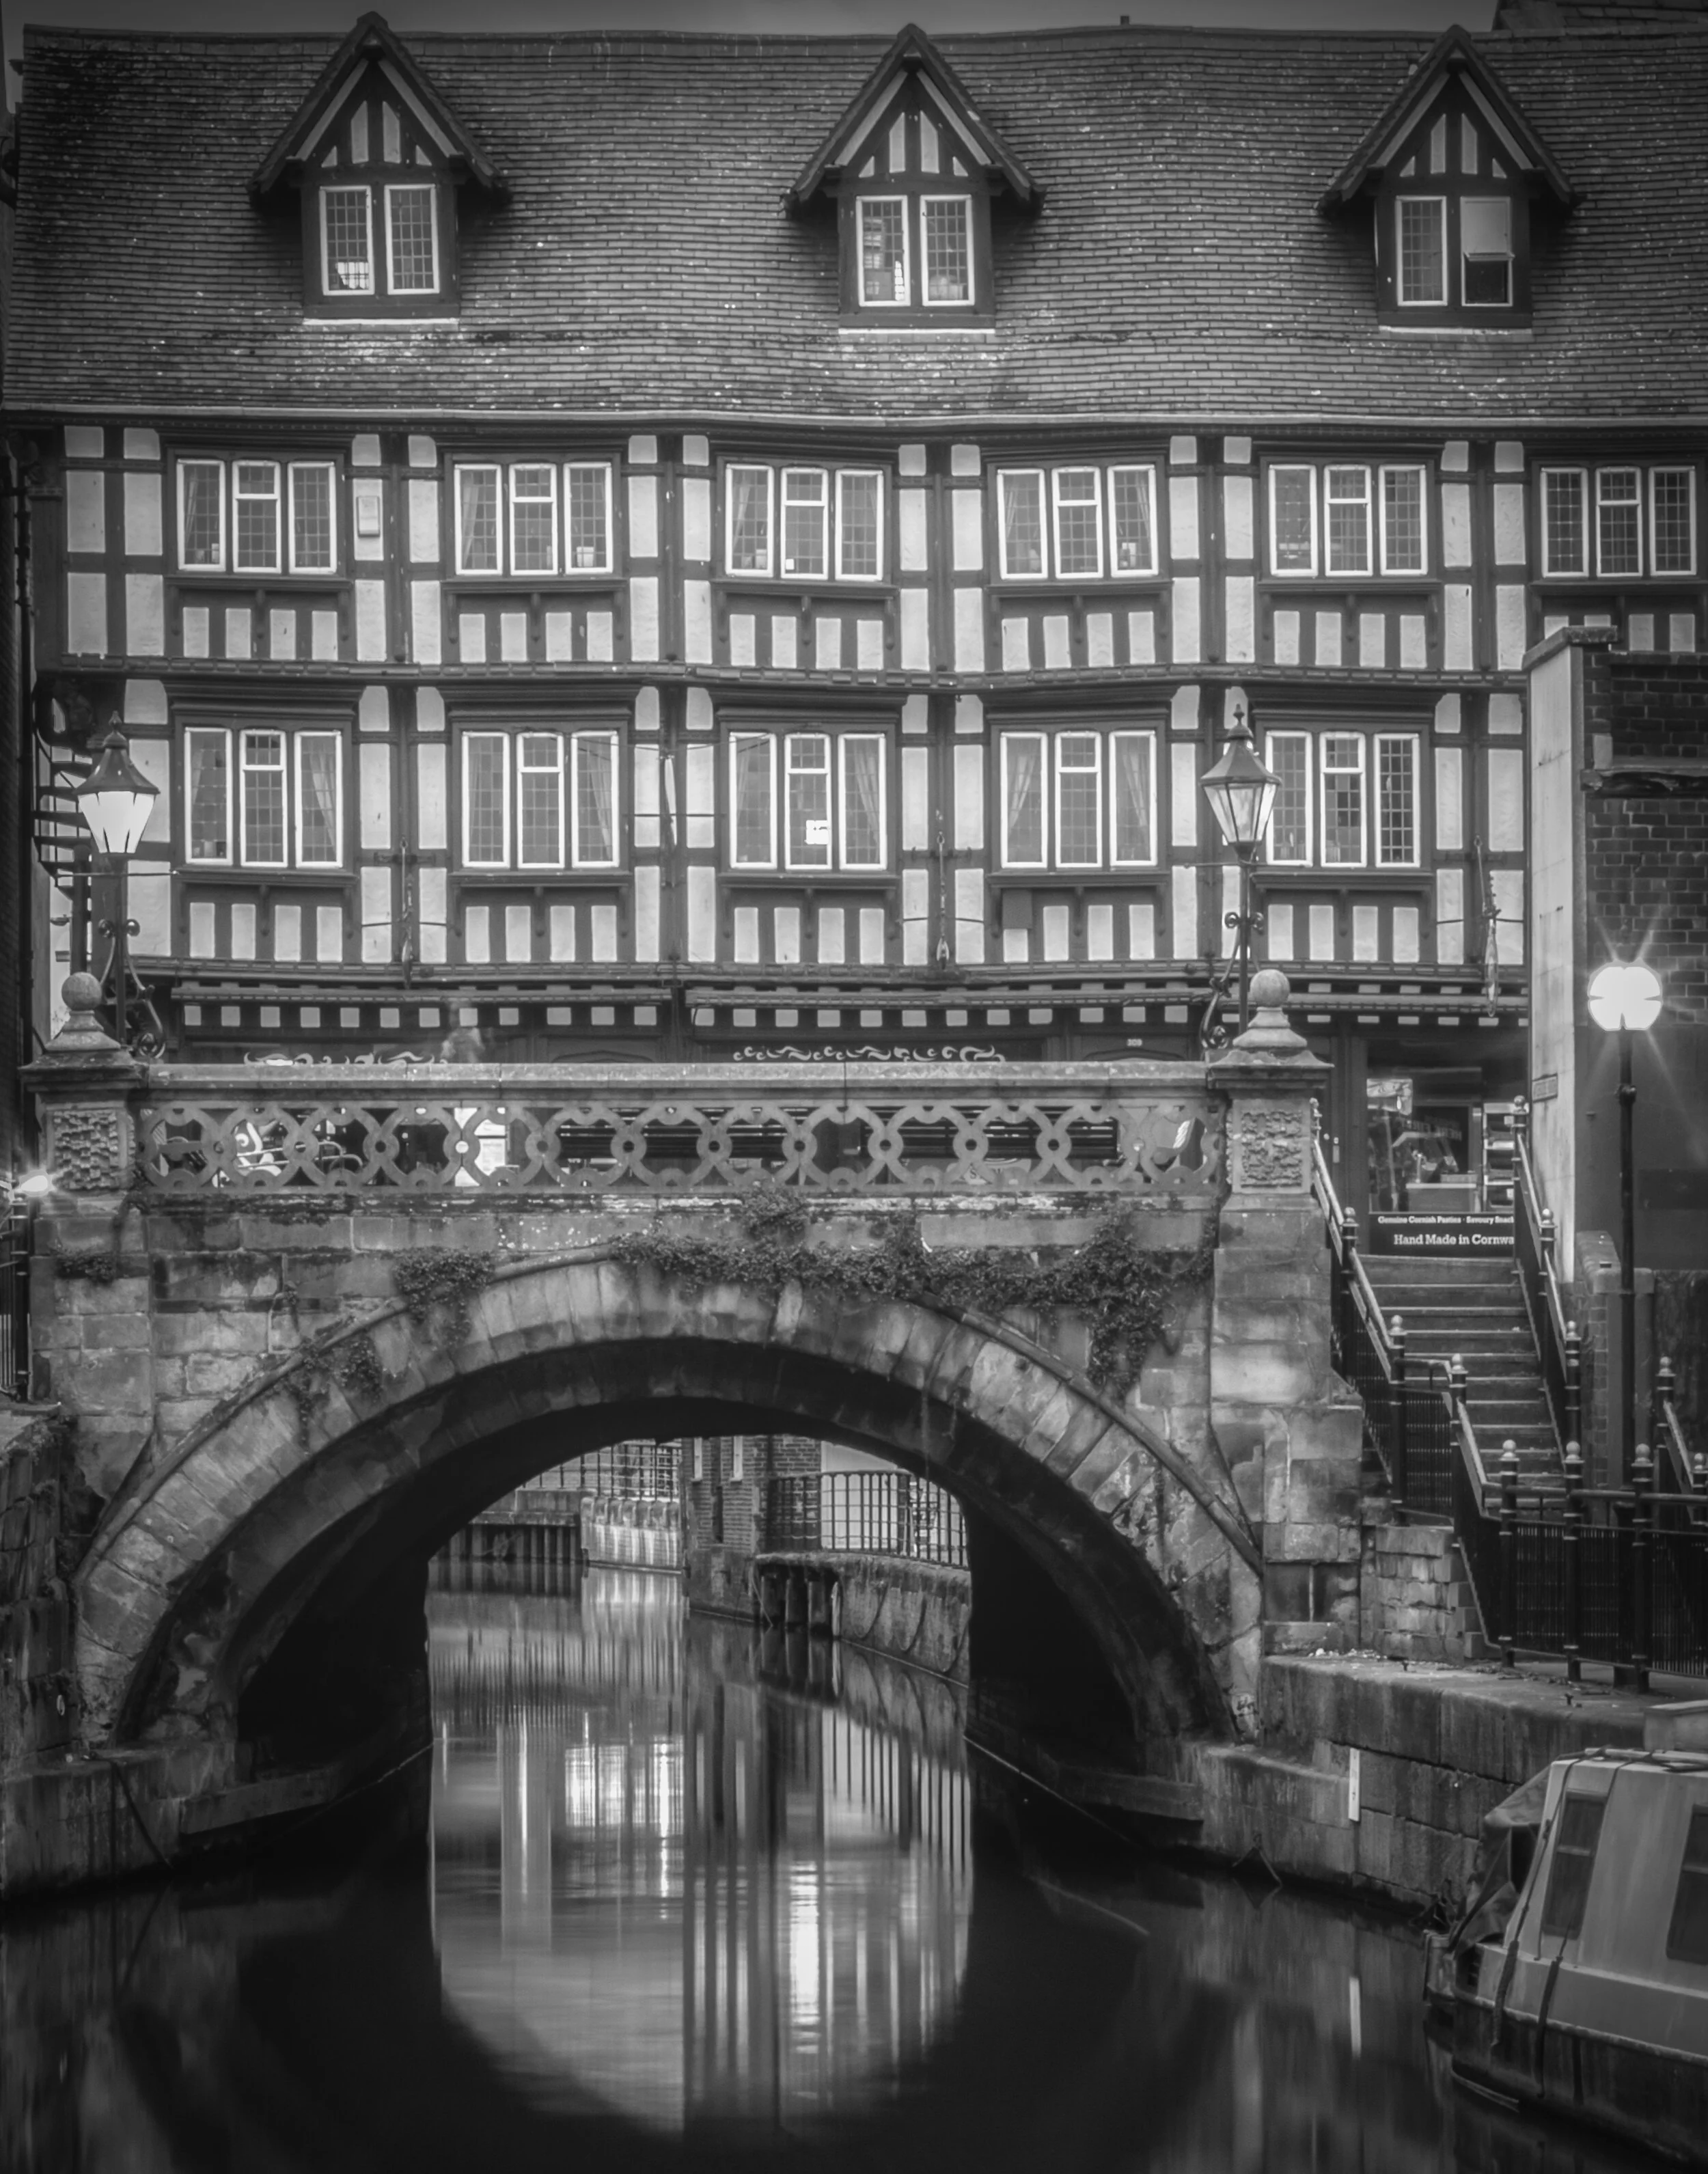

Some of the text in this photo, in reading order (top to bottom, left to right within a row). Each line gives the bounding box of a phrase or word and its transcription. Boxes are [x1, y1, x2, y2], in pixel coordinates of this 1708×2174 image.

[1378, 1215, 1407, 1224] Genuine
[1408, 1215, 1436, 1224] Cornish
[1437, 1215, 1461, 1224] Pasties
[1466, 1215, 1494, 1225] Savoury
[1394, 1234, 1424, 1245] Hand
[1425, 1234, 1457, 1245] Made
[1459, 1234, 1470, 1245] in
